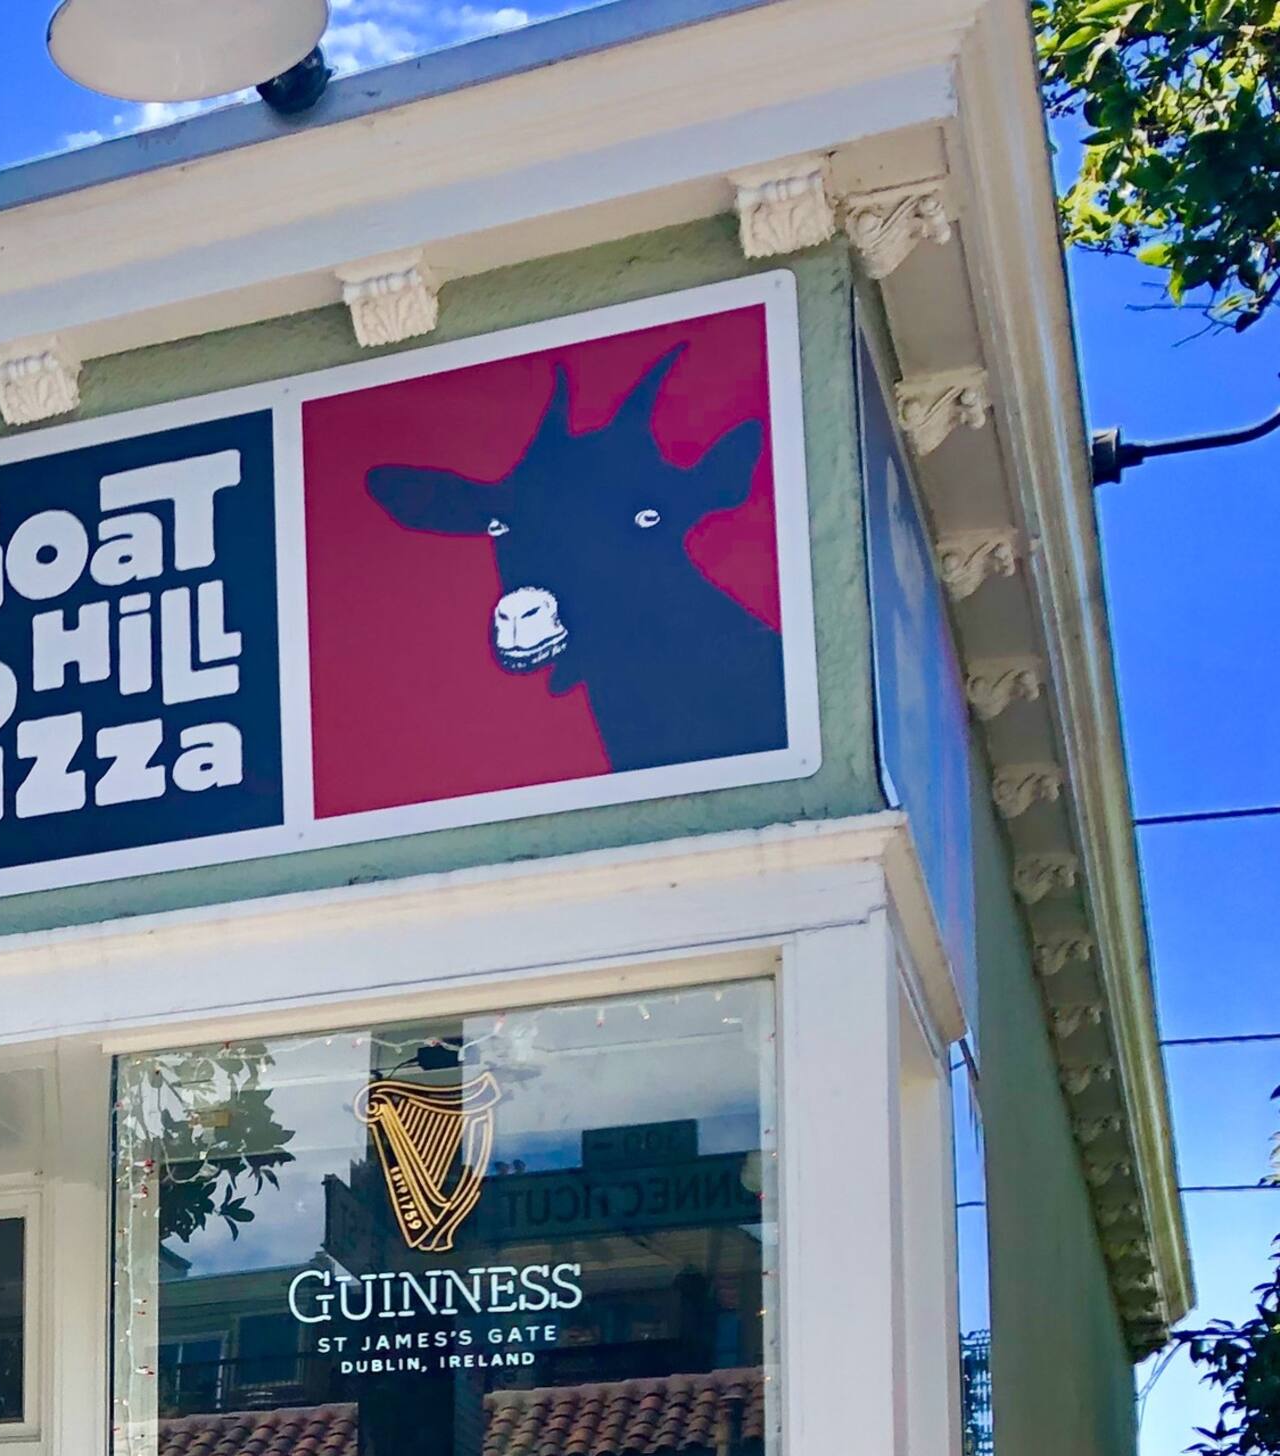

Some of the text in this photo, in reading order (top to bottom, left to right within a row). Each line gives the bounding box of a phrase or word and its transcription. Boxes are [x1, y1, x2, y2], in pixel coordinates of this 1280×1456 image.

[398, 1195, 423, 1230] 1759
[288, 1263, 583, 1324] GUINNESS
[317, 1324, 558, 1353] ST JAMES'S GATE
[340, 1352, 536, 1374] DUBLIN, IRELAND
